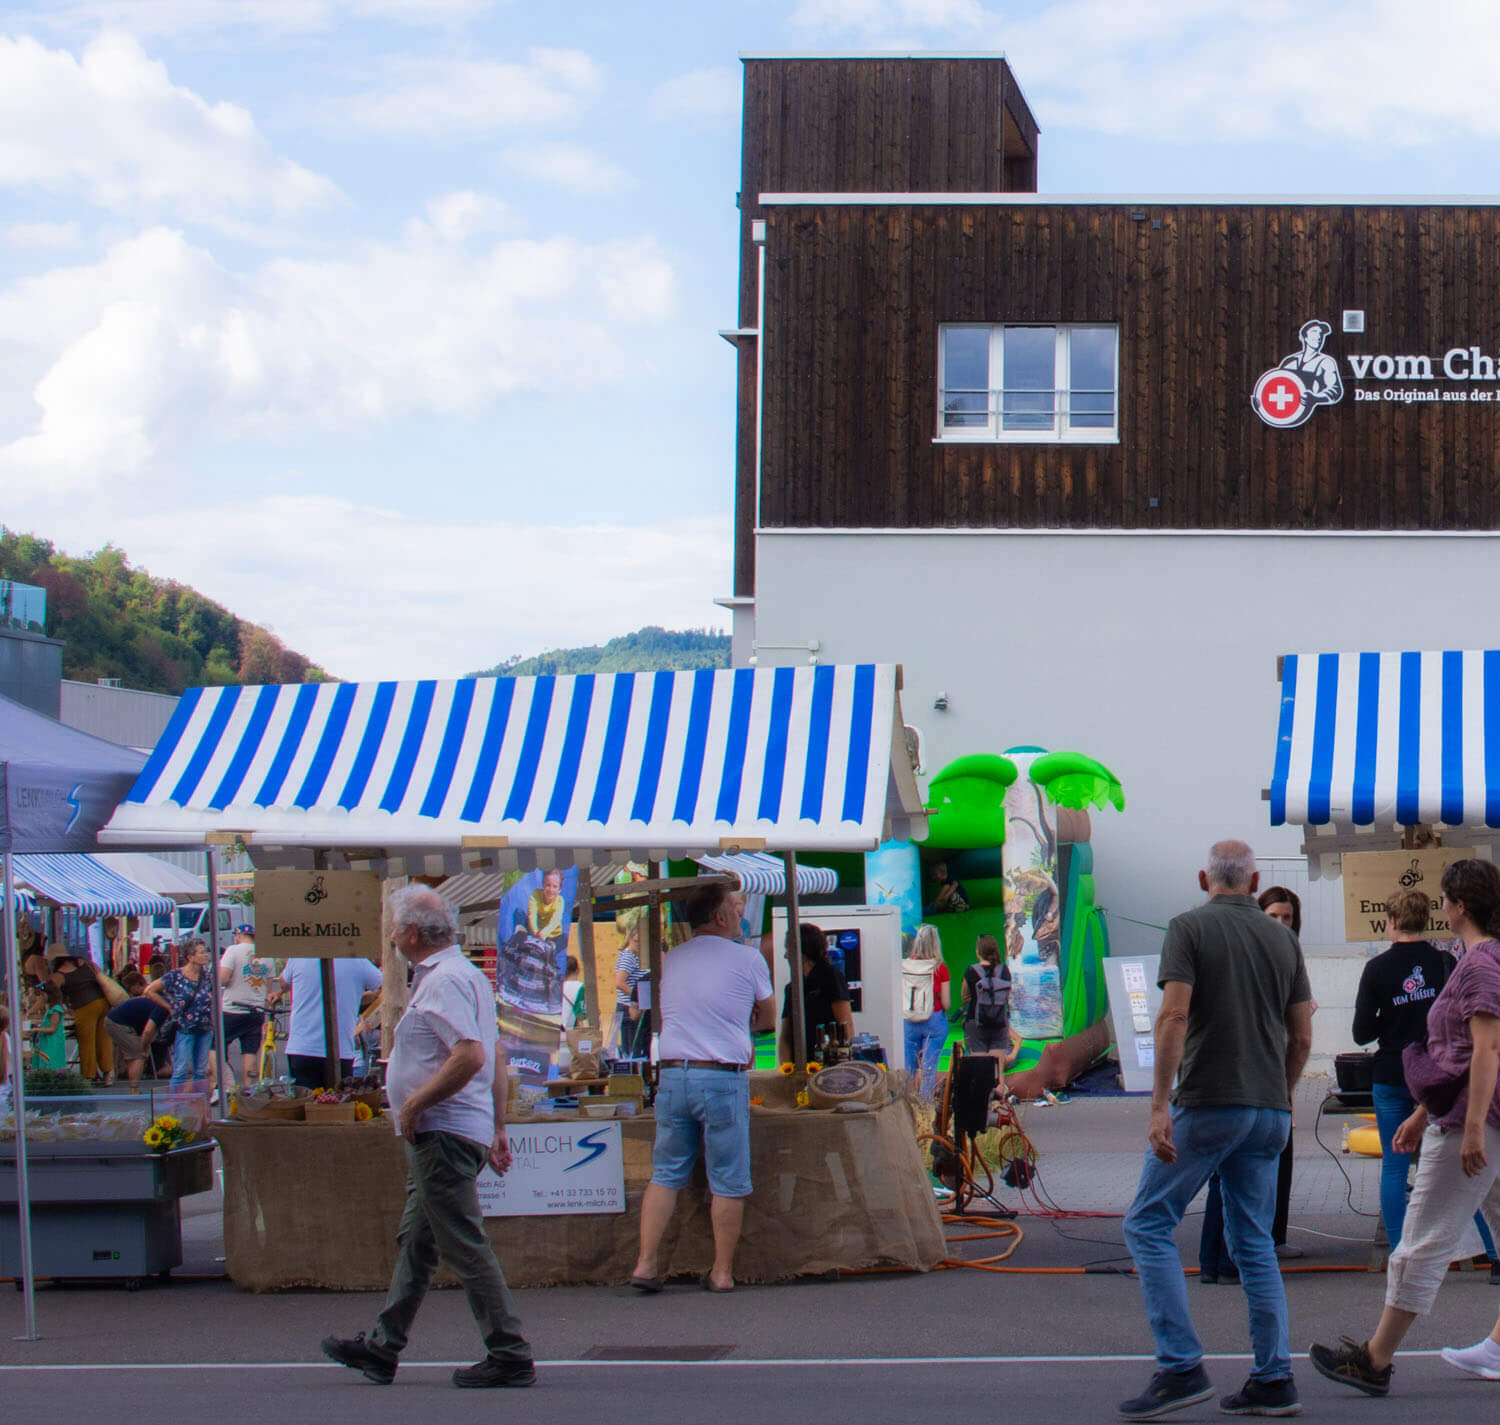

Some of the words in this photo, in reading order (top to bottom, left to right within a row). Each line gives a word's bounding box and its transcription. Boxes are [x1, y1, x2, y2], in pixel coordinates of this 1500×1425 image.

[1346, 355, 1434, 380] vom
[1354, 389, 1380, 401] Das
[1383, 388, 1439, 404] Original
[1442, 390, 1467, 402] aus
[1470, 388, 1494, 402] der
[272, 923, 312, 937] Lenk
[315, 923, 361, 937] Milch
[509, 1136, 572, 1154] MILCH
